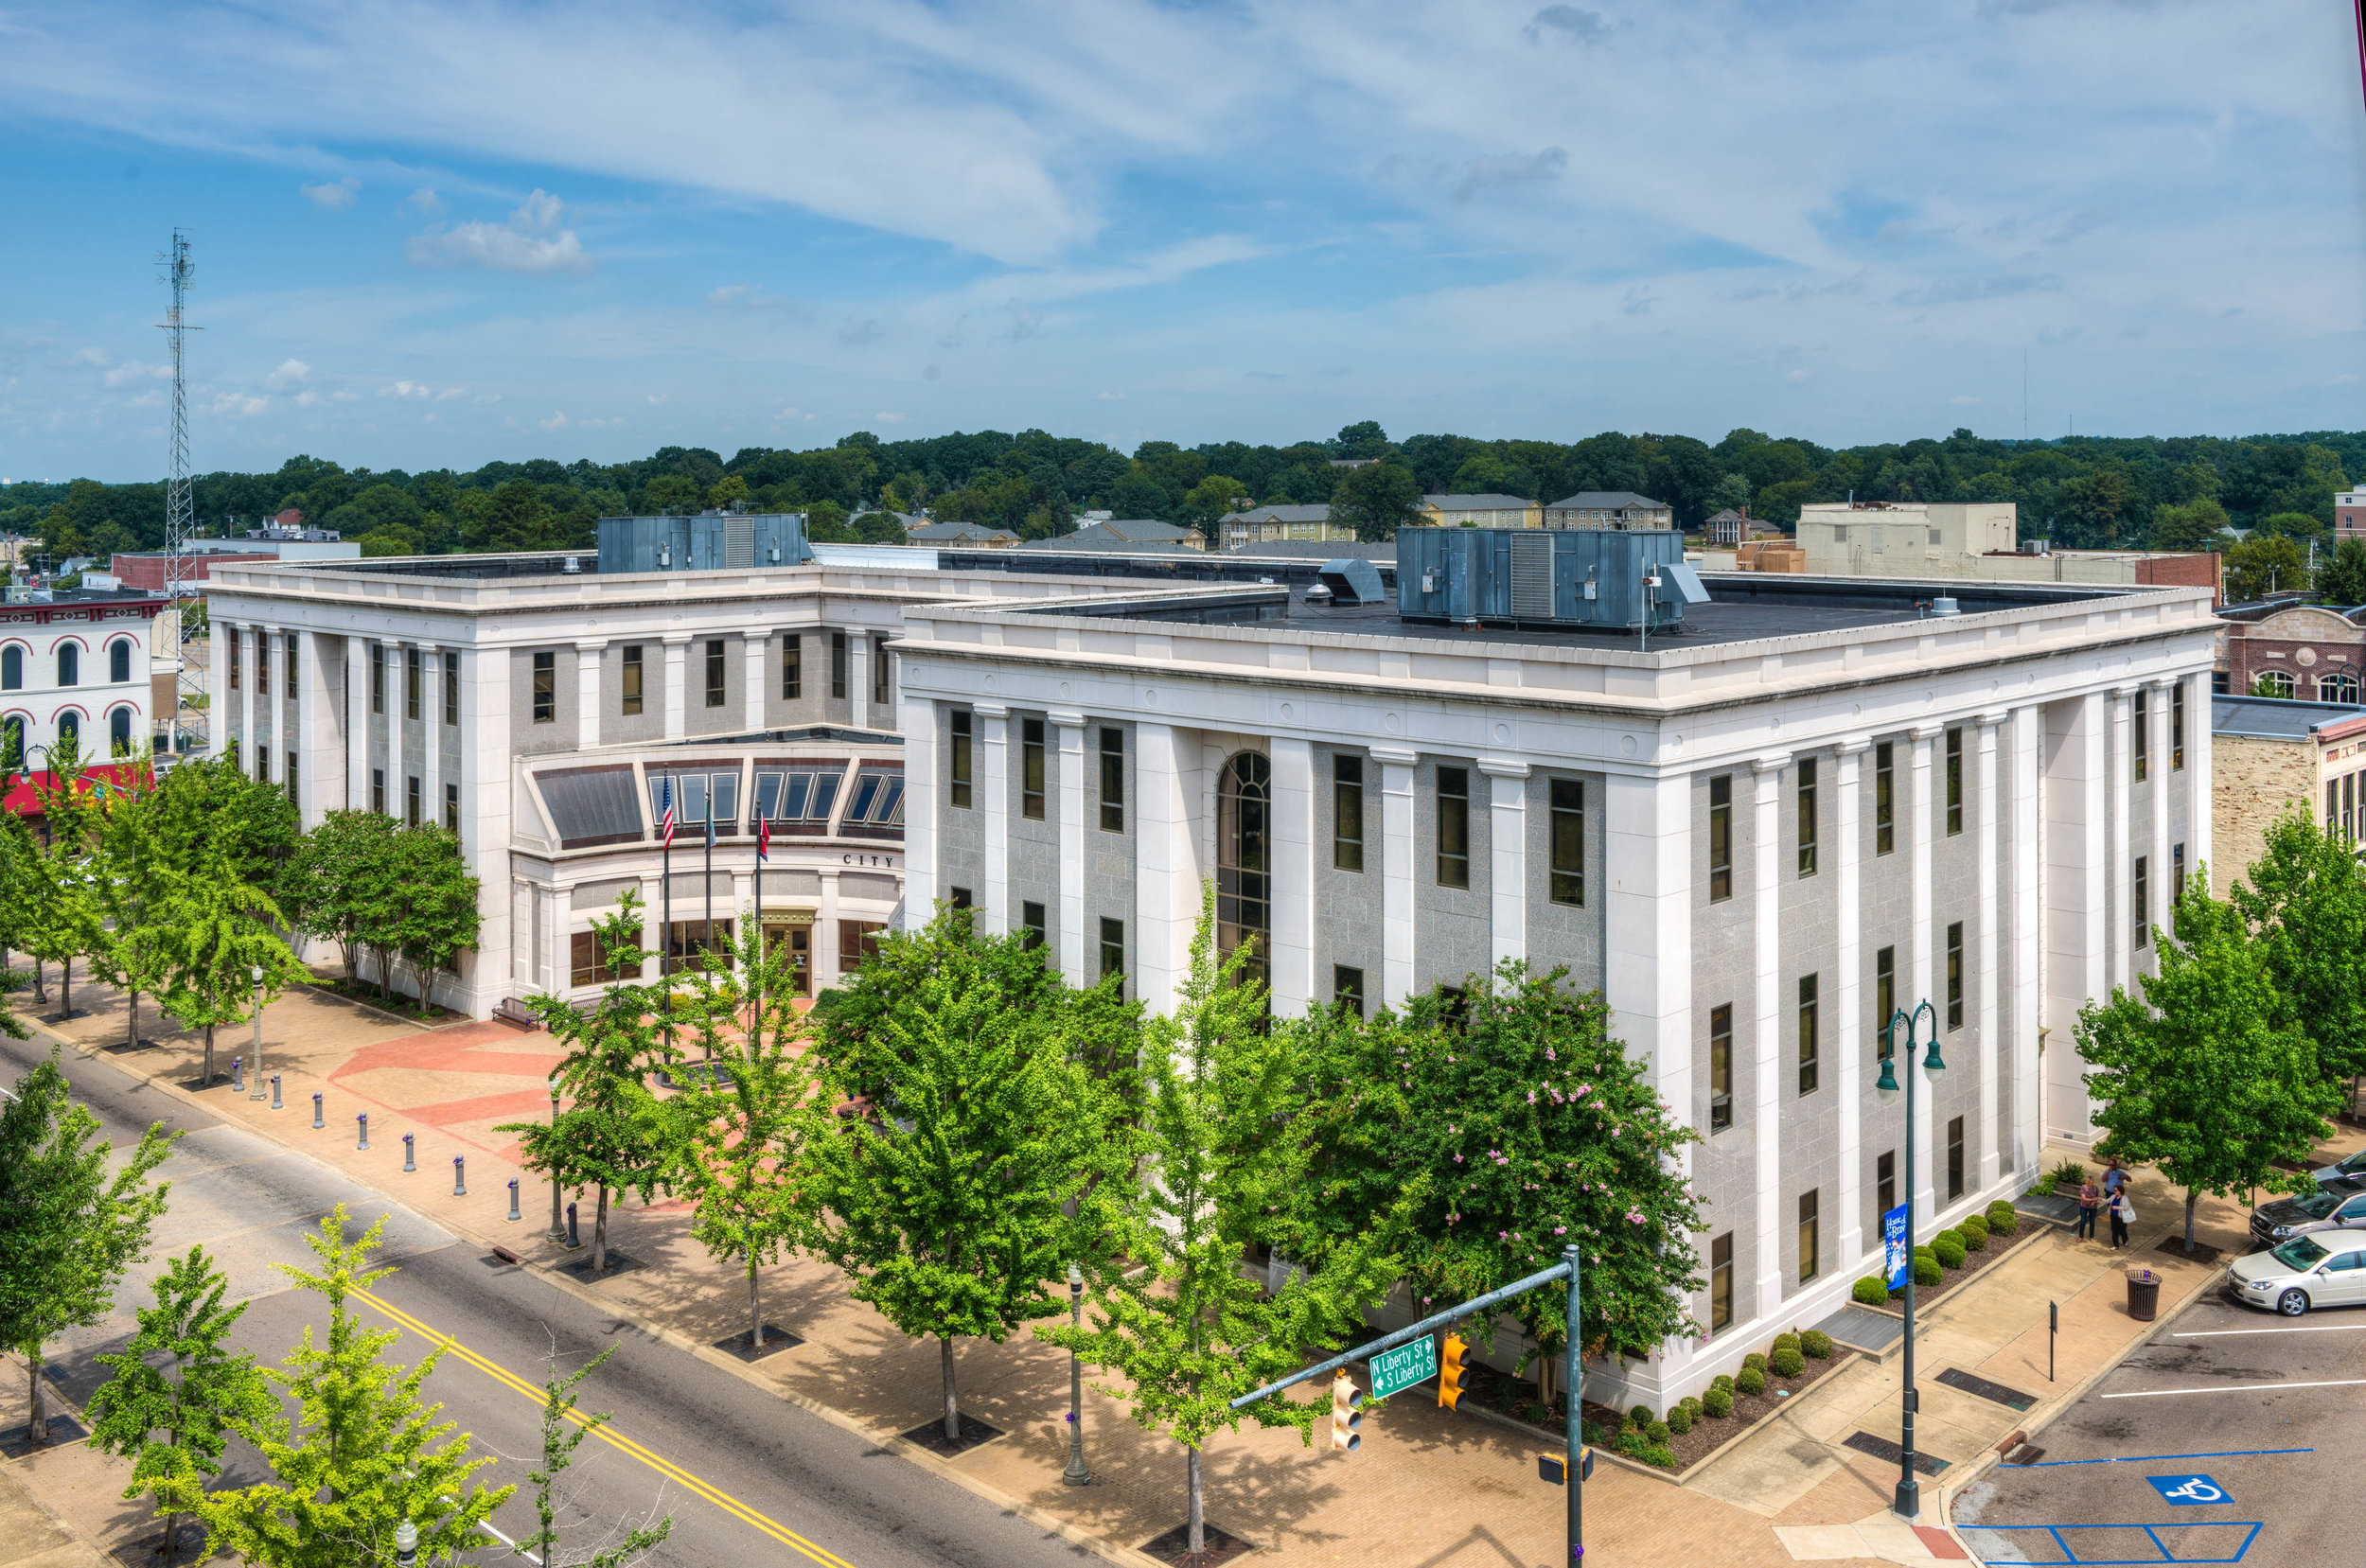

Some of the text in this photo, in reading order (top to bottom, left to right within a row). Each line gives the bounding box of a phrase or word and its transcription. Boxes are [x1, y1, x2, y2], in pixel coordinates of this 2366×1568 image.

[843, 854, 892, 868] CITY
[1886, 1217, 1901, 1230] Home
[1372, 1343, 1423, 1376] N Liberty St
[1387, 1354, 1435, 1388] S Liberty St
